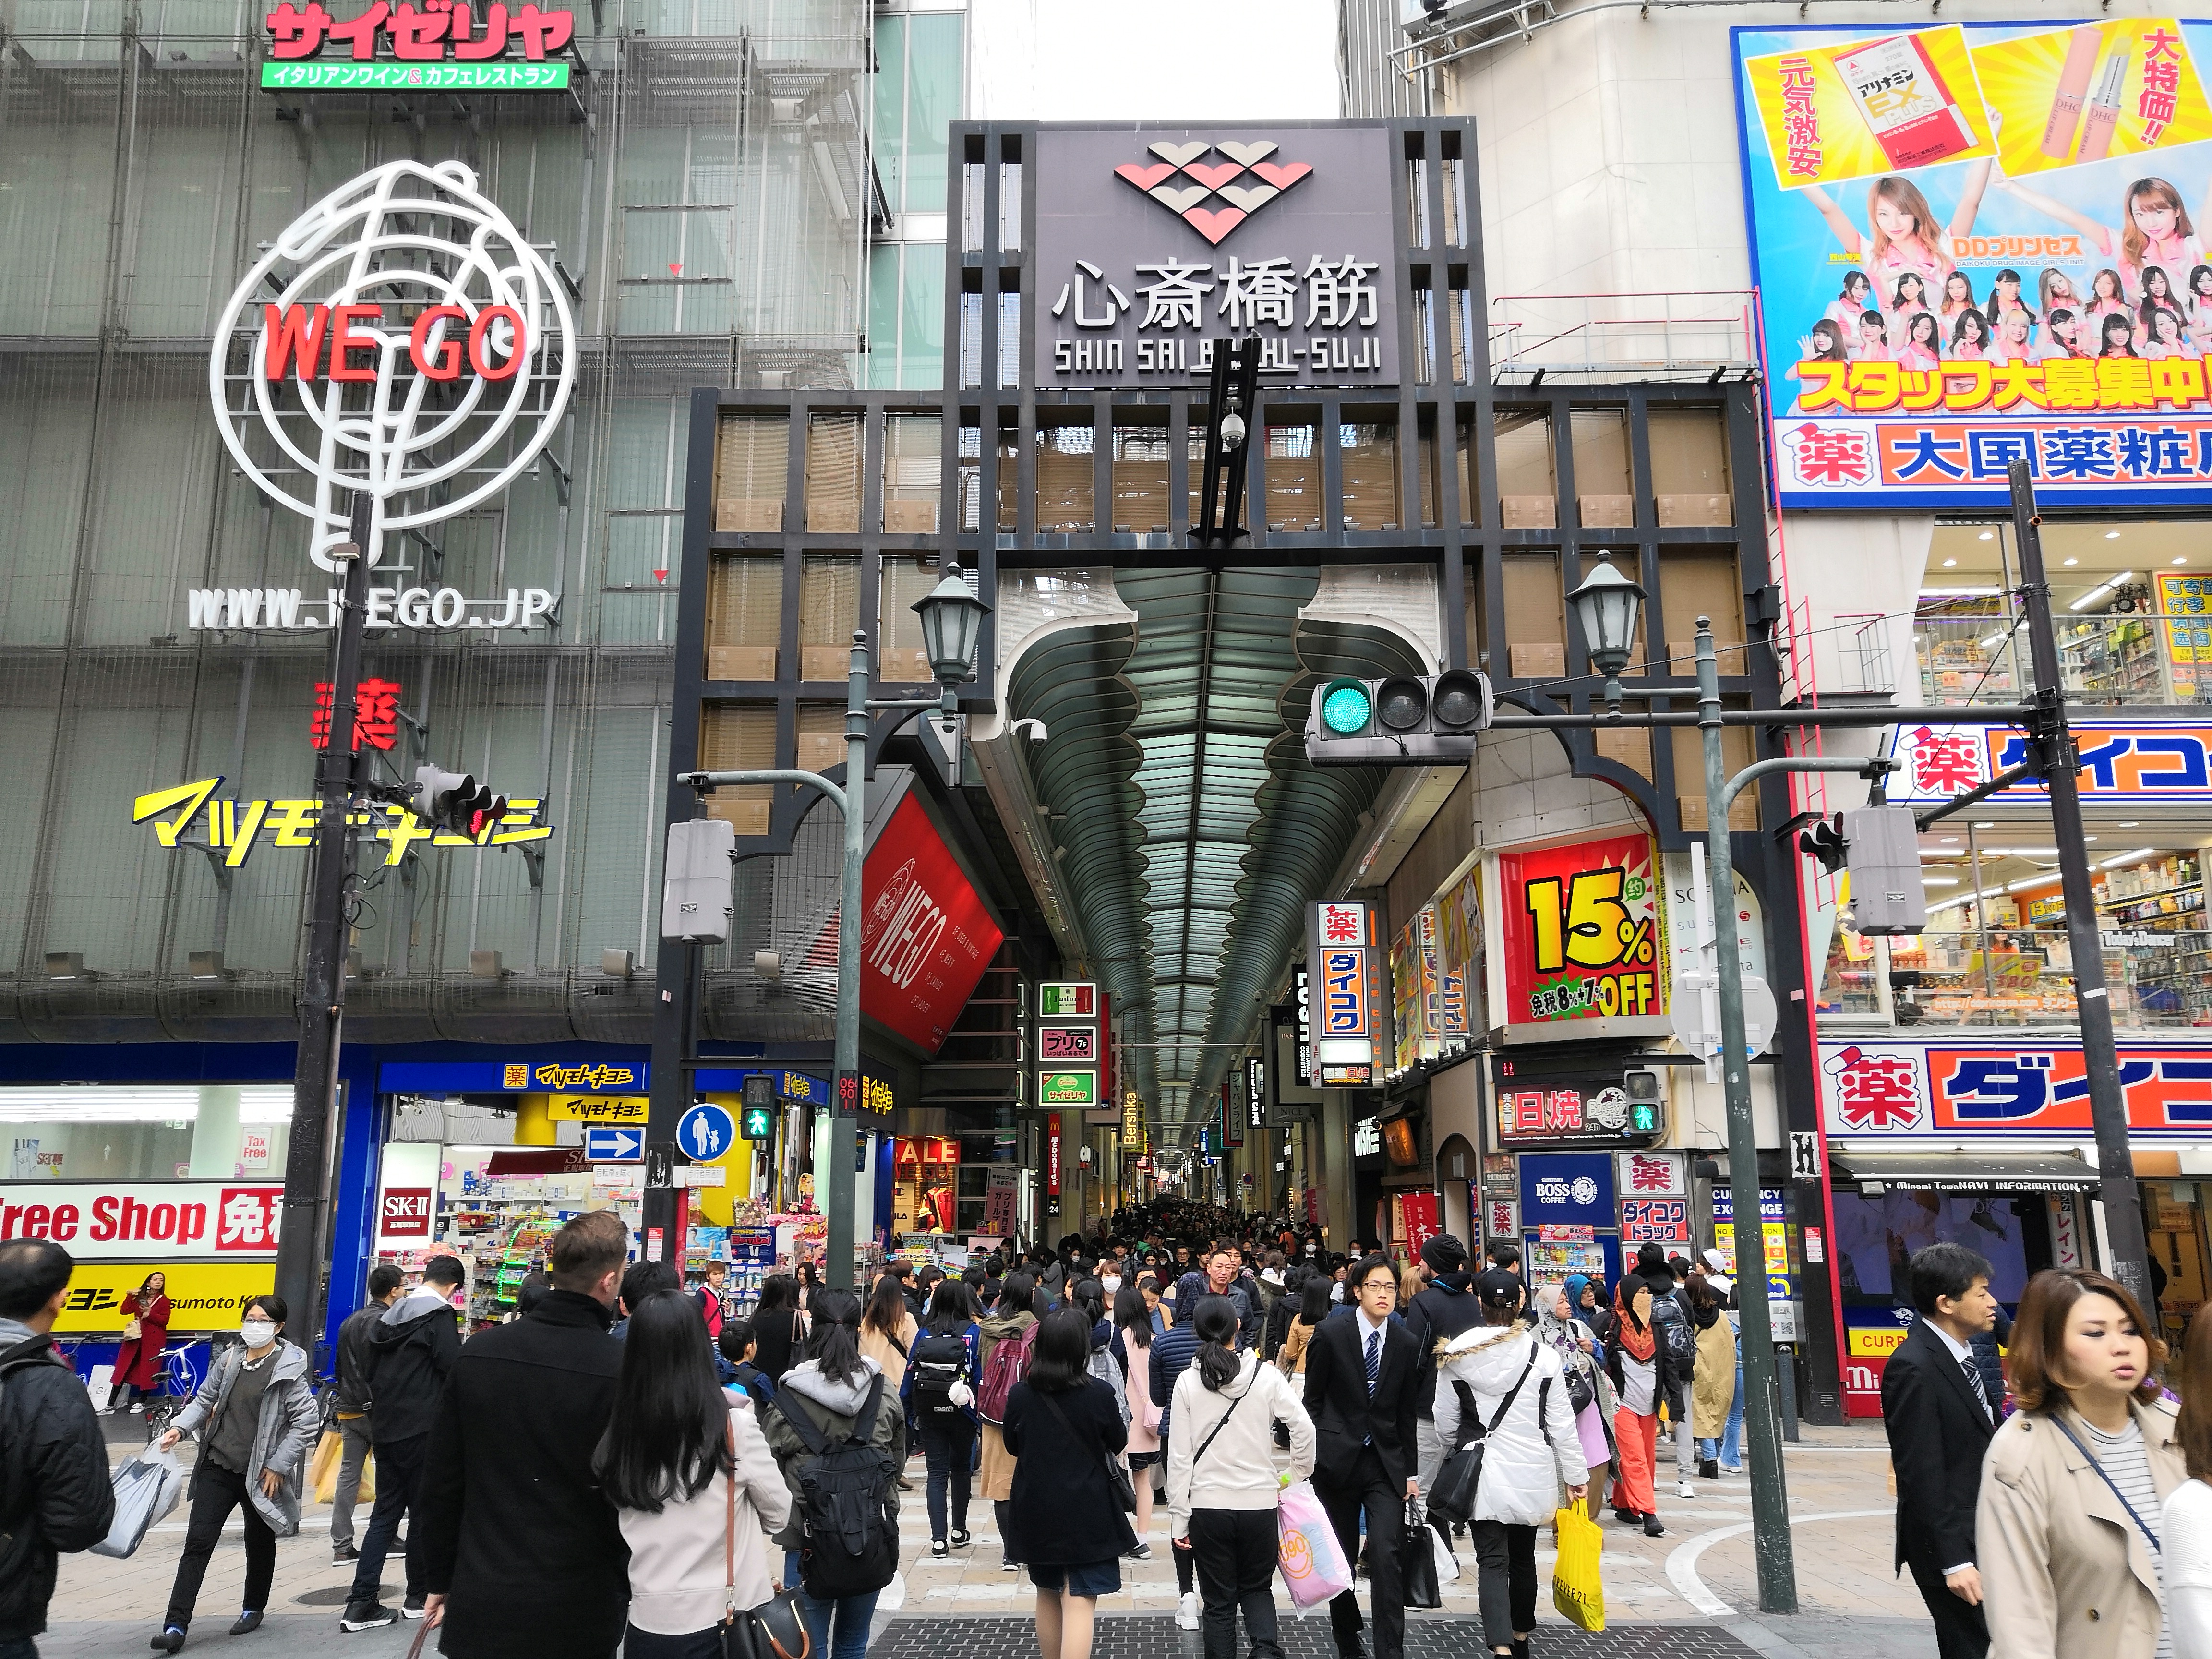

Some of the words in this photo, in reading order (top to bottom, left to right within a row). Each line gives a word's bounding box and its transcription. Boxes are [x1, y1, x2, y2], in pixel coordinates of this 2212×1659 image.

[267, 0, 573, 60] サイゼリヤ
[1857, 68, 1914, 98] アリナミン
[1864, 80, 1923, 119] EX
[1884, 95, 1937, 127] PLUS
[2055, 98, 2081, 113] DHC
[1779, 58, 1822, 178] 元気激安
[2090, 108, 2116, 122] DHC
[1953, 237, 2084, 257] DDプリンセス
[1052, 254, 1381, 330] 心斎橋筋
[1055, 339, 1124, 372] SHIN
[1137, 339, 1186, 372] SAI
[189, 588, 554, 629] WWW.EGO.JP
[2167, 597, 2205, 613] 行李
[868, 880, 947, 990] WEGO
[1325, 905, 1358, 942] 薬
[1526, 866, 1657, 974] 15%
[2138, 931, 2176, 946] Dancer
[1329, 953, 1358, 1030] ダイコク
[1598, 970, 1654, 1017] OFF
[1047, 1035, 1074, 1051] プリ
[1077, 1040, 1087, 1048] 7F
[506, 1066, 527, 1086] 薬
[536, 1063, 634, 1089] マツモトキヨシ
[1322, 1067, 1369, 1079] 個室日焼
[1839, 1045, 1916, 1126] 薬
[566, 1099, 644, 1119] マツモトキヨシ
[1048, 1091, 1086, 1100] サイゼリヤ
[1232, 1074, 1241, 1139] ジャパンライフ
[1515, 1089, 1582, 1130] 日焼
[1123, 1092, 1137, 1145] Bershka
[1585, 1123, 1601, 1131] 24h
[243, 1147, 267, 1159] Free
[247, 1135, 265, 1147] Tax
[895, 1141, 957, 1163] ALE
[1050, 1136, 1059, 1186] McDonald's
[1631, 1154, 1672, 1190] 薬
[1536, 1183, 1570, 1197] BOSS
[1896, 1181, 1932, 1189] Minami
[1996, 1181, 2080, 1191] INFORMATION
[90, 1195, 207, 1245] Shop
[384, 1196, 428, 1217] SK-II
[1049, 1205, 1059, 1214] 24
[1493, 1201, 1512, 1235] 薬
[1623, 1201, 1685, 1223] ダイコク
[1632, 1225, 1677, 1240] ドラッグ
